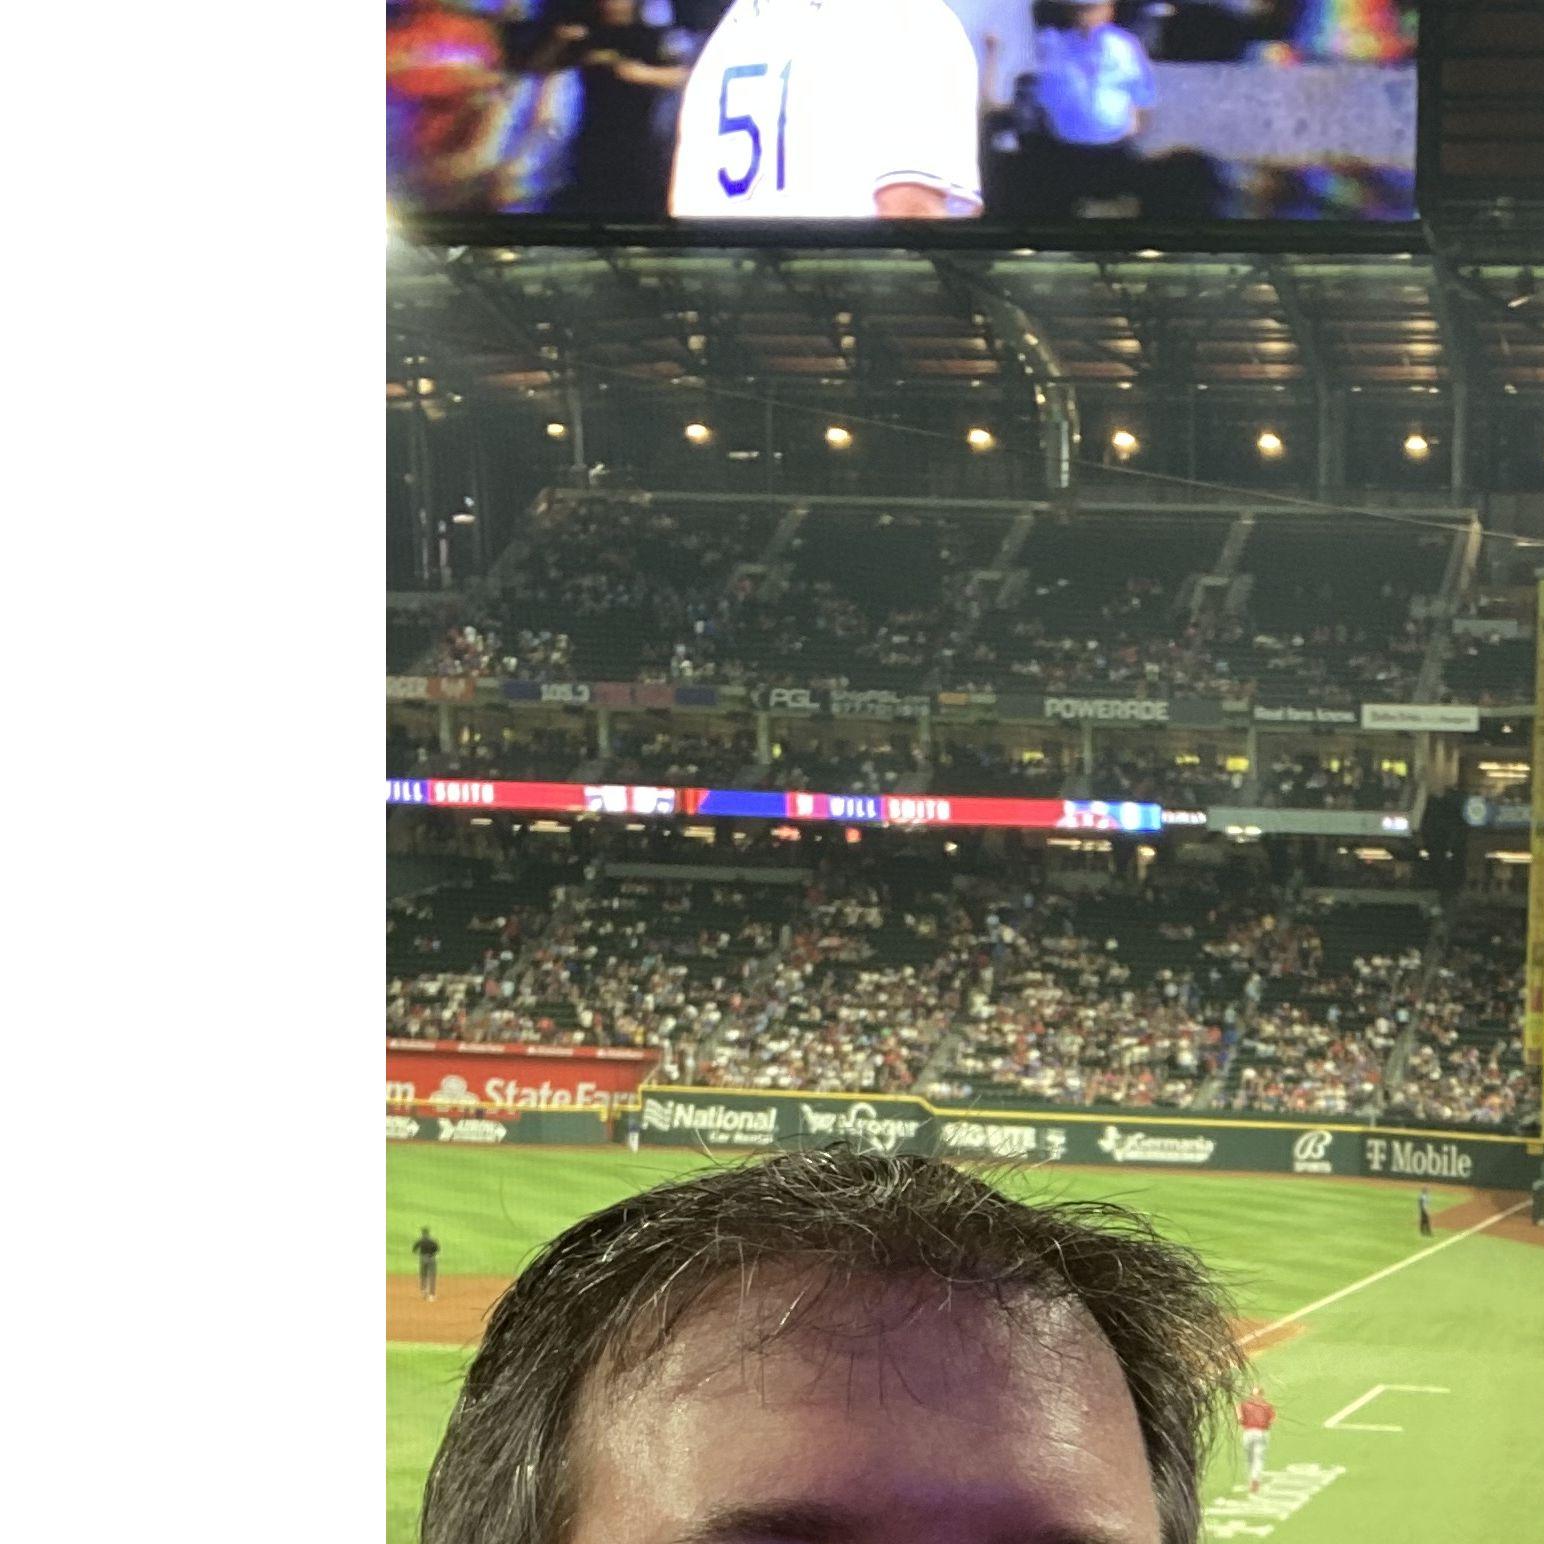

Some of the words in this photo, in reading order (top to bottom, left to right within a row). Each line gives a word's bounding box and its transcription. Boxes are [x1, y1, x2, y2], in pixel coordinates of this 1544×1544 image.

[718, 61, 792, 198] 51
[485, 1077, 571, 1108] State
[673, 1103, 778, 1132] National
[1391, 1140, 1472, 1178] Mobile
